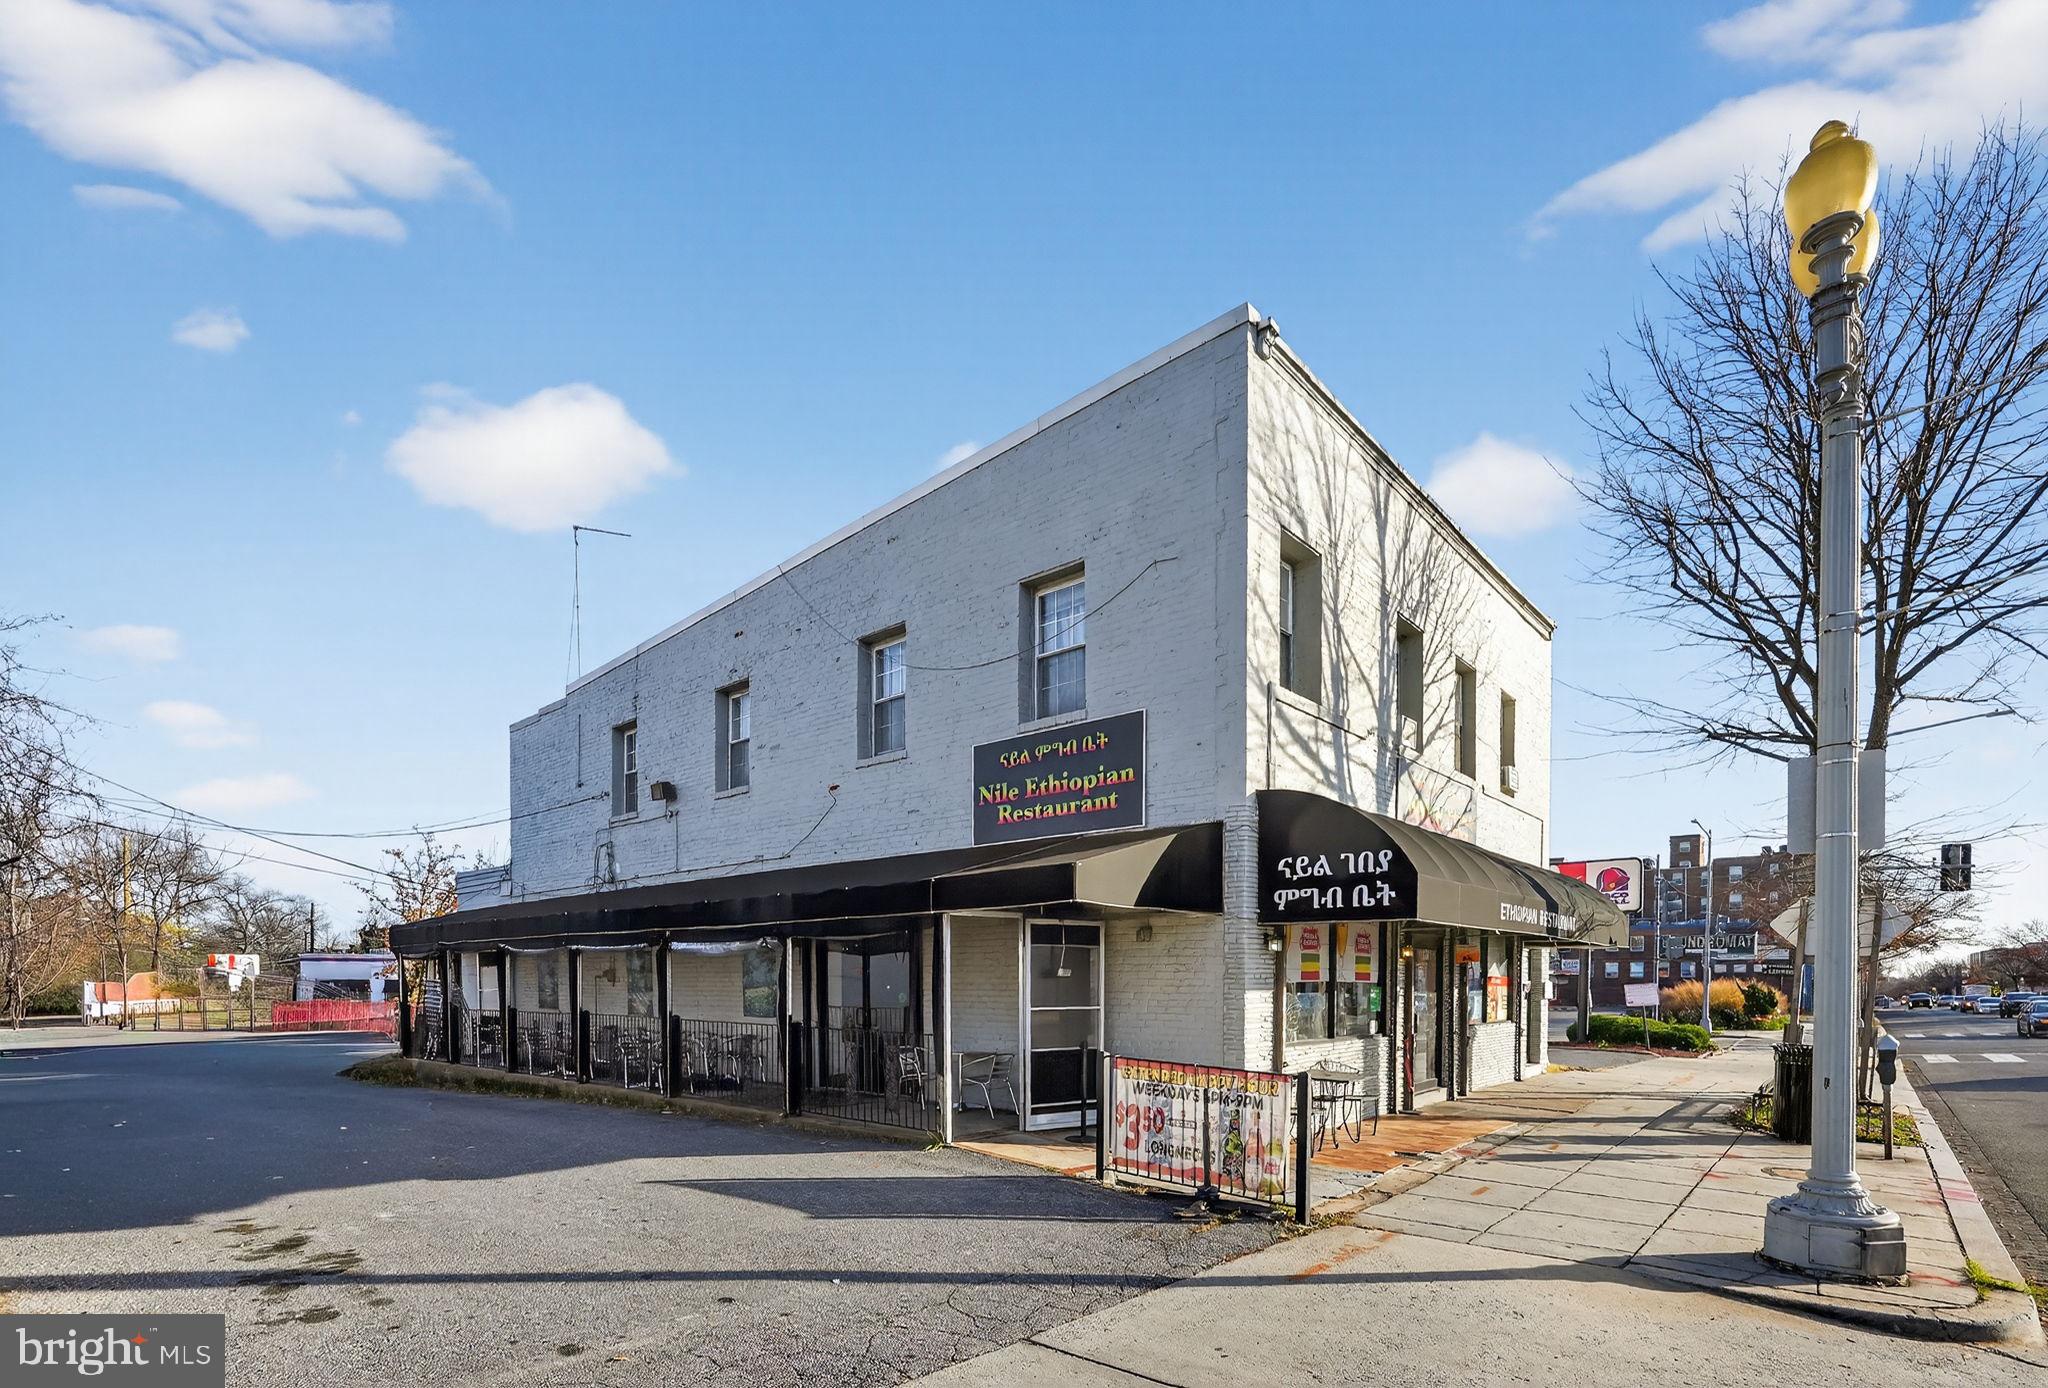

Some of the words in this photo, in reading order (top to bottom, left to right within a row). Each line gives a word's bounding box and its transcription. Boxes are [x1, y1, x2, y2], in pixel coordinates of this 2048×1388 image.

[1082, 731, 1108, 752] ቤት
[978, 783, 1020, 806] Nile
[1025, 764, 1135, 799] Ethiopian
[997, 791, 1118, 825] Restaurant
[1277, 854, 1333, 881] ናይል
[1340, 849, 1393, 875] ገበያ
[1273, 886, 1344, 911] ምግብ
[1352, 880, 1396, 907] ቤት
[1132, 1081, 1200, 1102] WEEKDAYS
[1237, 1077, 1279, 1097] HOUR
[1145, 1139, 1216, 1166] LONGNECS
